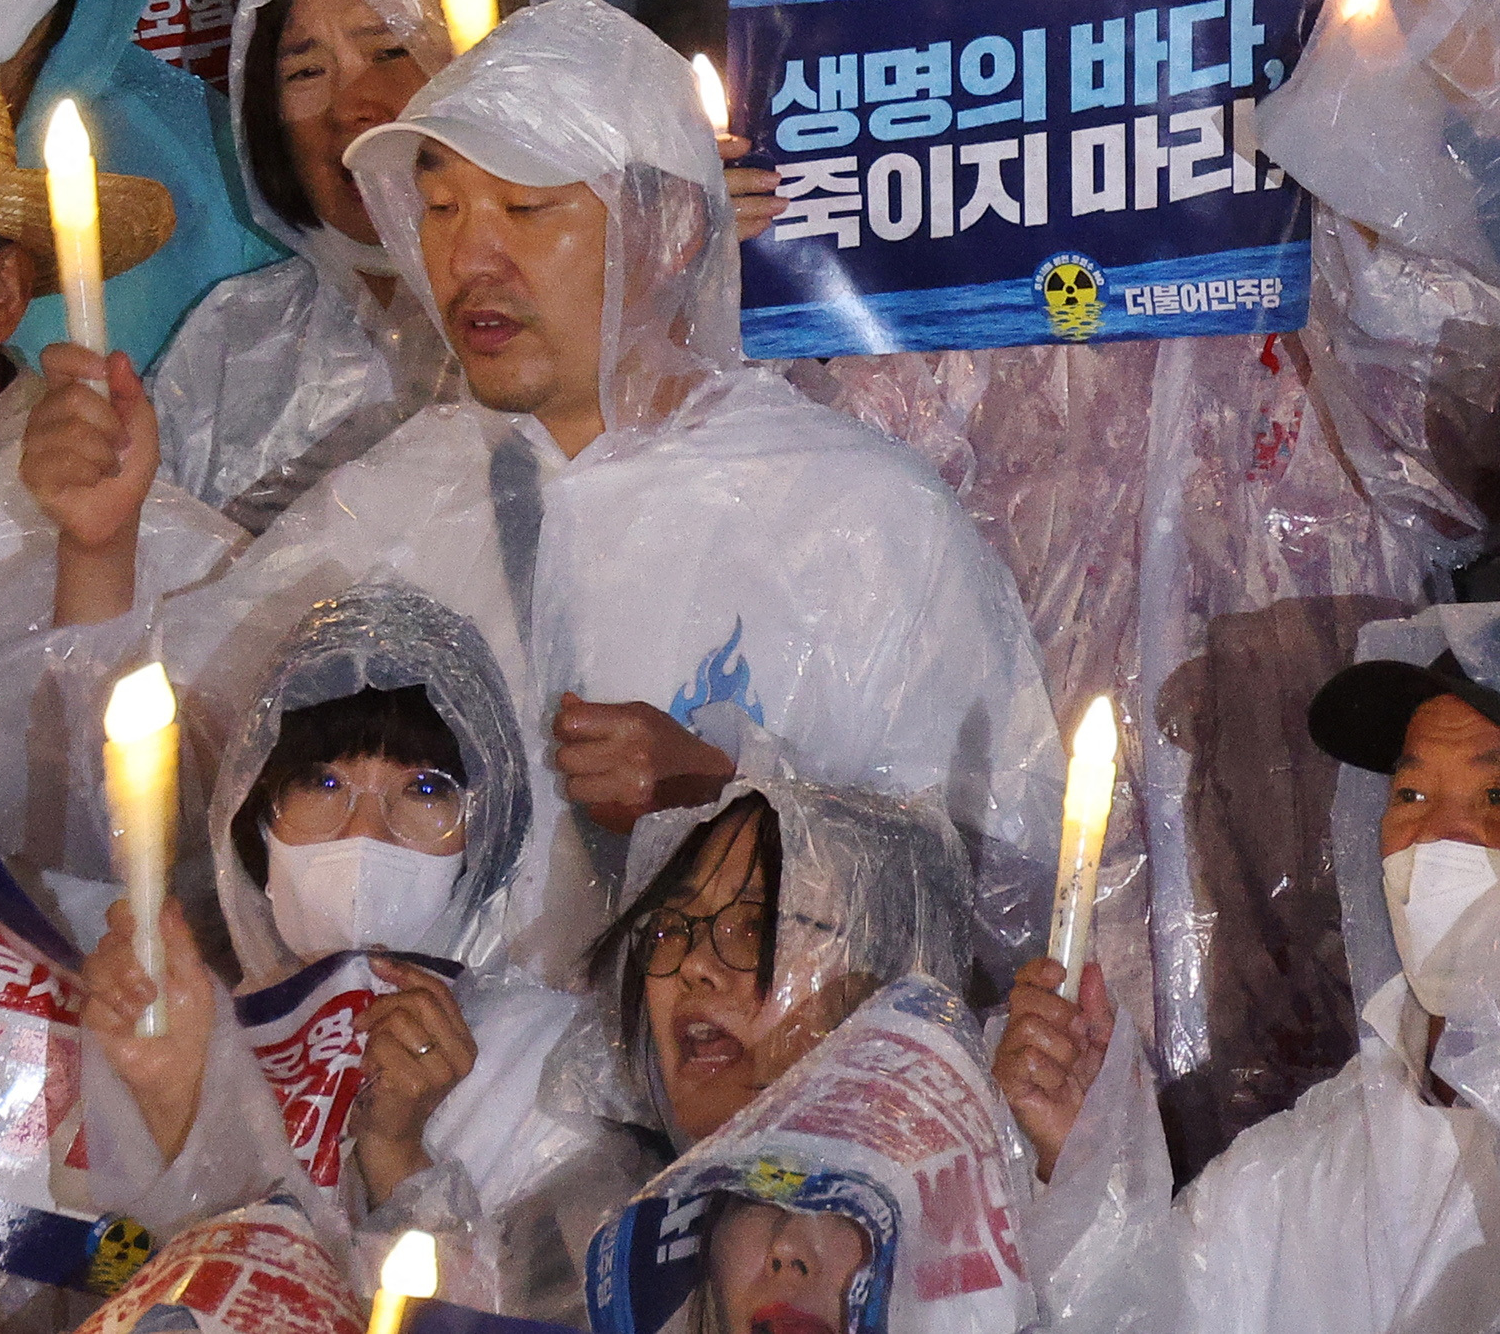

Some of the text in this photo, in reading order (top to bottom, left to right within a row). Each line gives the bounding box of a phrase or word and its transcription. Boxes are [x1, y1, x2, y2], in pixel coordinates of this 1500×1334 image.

[771, 28, 1047, 154] 생명의
[772, 132, 1048, 250] 죽이지
[1124, 278, 1284, 320] 더불어민주당
